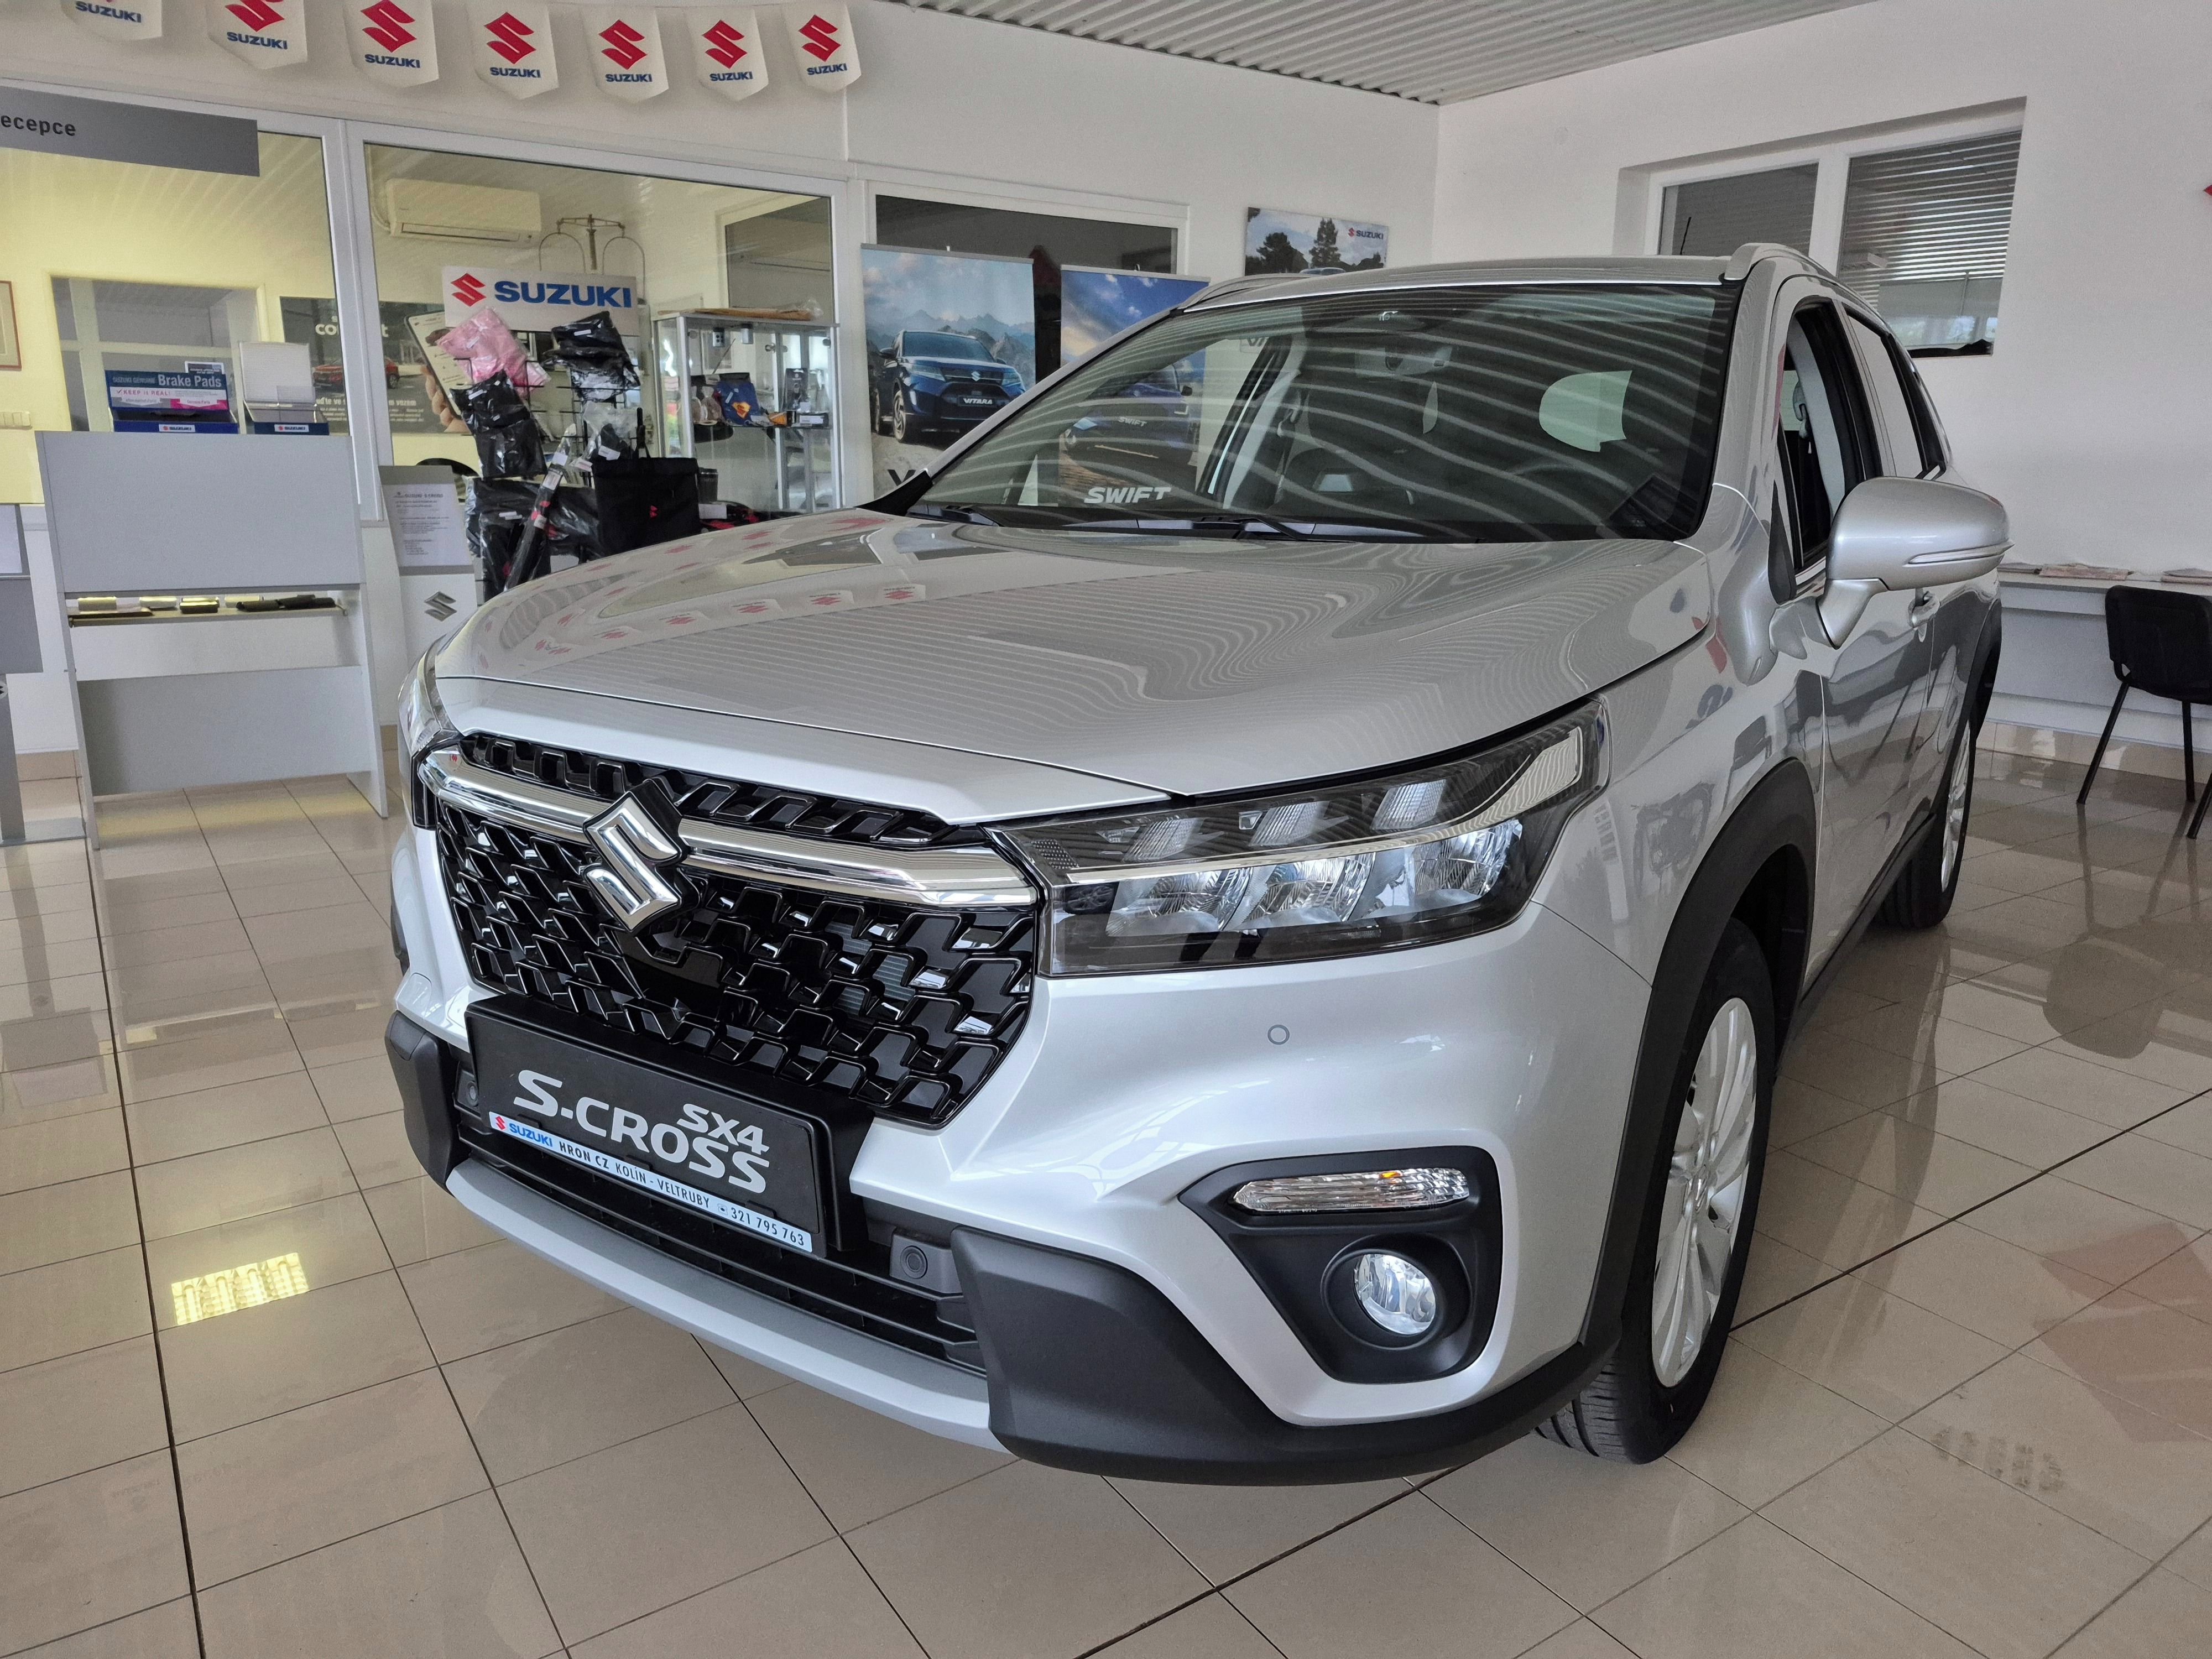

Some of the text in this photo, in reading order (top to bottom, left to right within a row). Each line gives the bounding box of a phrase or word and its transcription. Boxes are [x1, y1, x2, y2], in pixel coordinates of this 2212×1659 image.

[76, 1, 142, 23] SUZUKI
[226, 32, 288, 50] SUZUKI
[364, 54, 421, 68] SUZUKI
[490, 67, 541, 78] SUZUKI
[709, 71, 753, 81] SUZUKI
[806, 63, 848, 76] SUZUKI
[606, 73, 653, 82] SUZUKI
[0, 114, 76, 137] ecepce
[1356, 230, 1384, 240] SUZUKI
[494, 280, 632, 308] SUZUKI
[158, 374, 191, 387] Brake
[194, 375, 222, 388] Pads
[1118, 416, 1147, 427] SWIFT
[1084, 487, 1172, 504] SWIFT
[676, 1103, 770, 1155] SX4
[509, 1123, 553, 1148] SUZUKI
[559, 1141, 591, 1162] HRON
[595, 1155, 609, 1170] CZ
[615, 1162, 646, 1184] KOLÍN
[657, 1178, 709, 1208] VELTRUBY
[731, 1207, 750, 1225] 321
[757, 1217, 778, 1235] 795
[782, 1227, 804, 1246] 763
